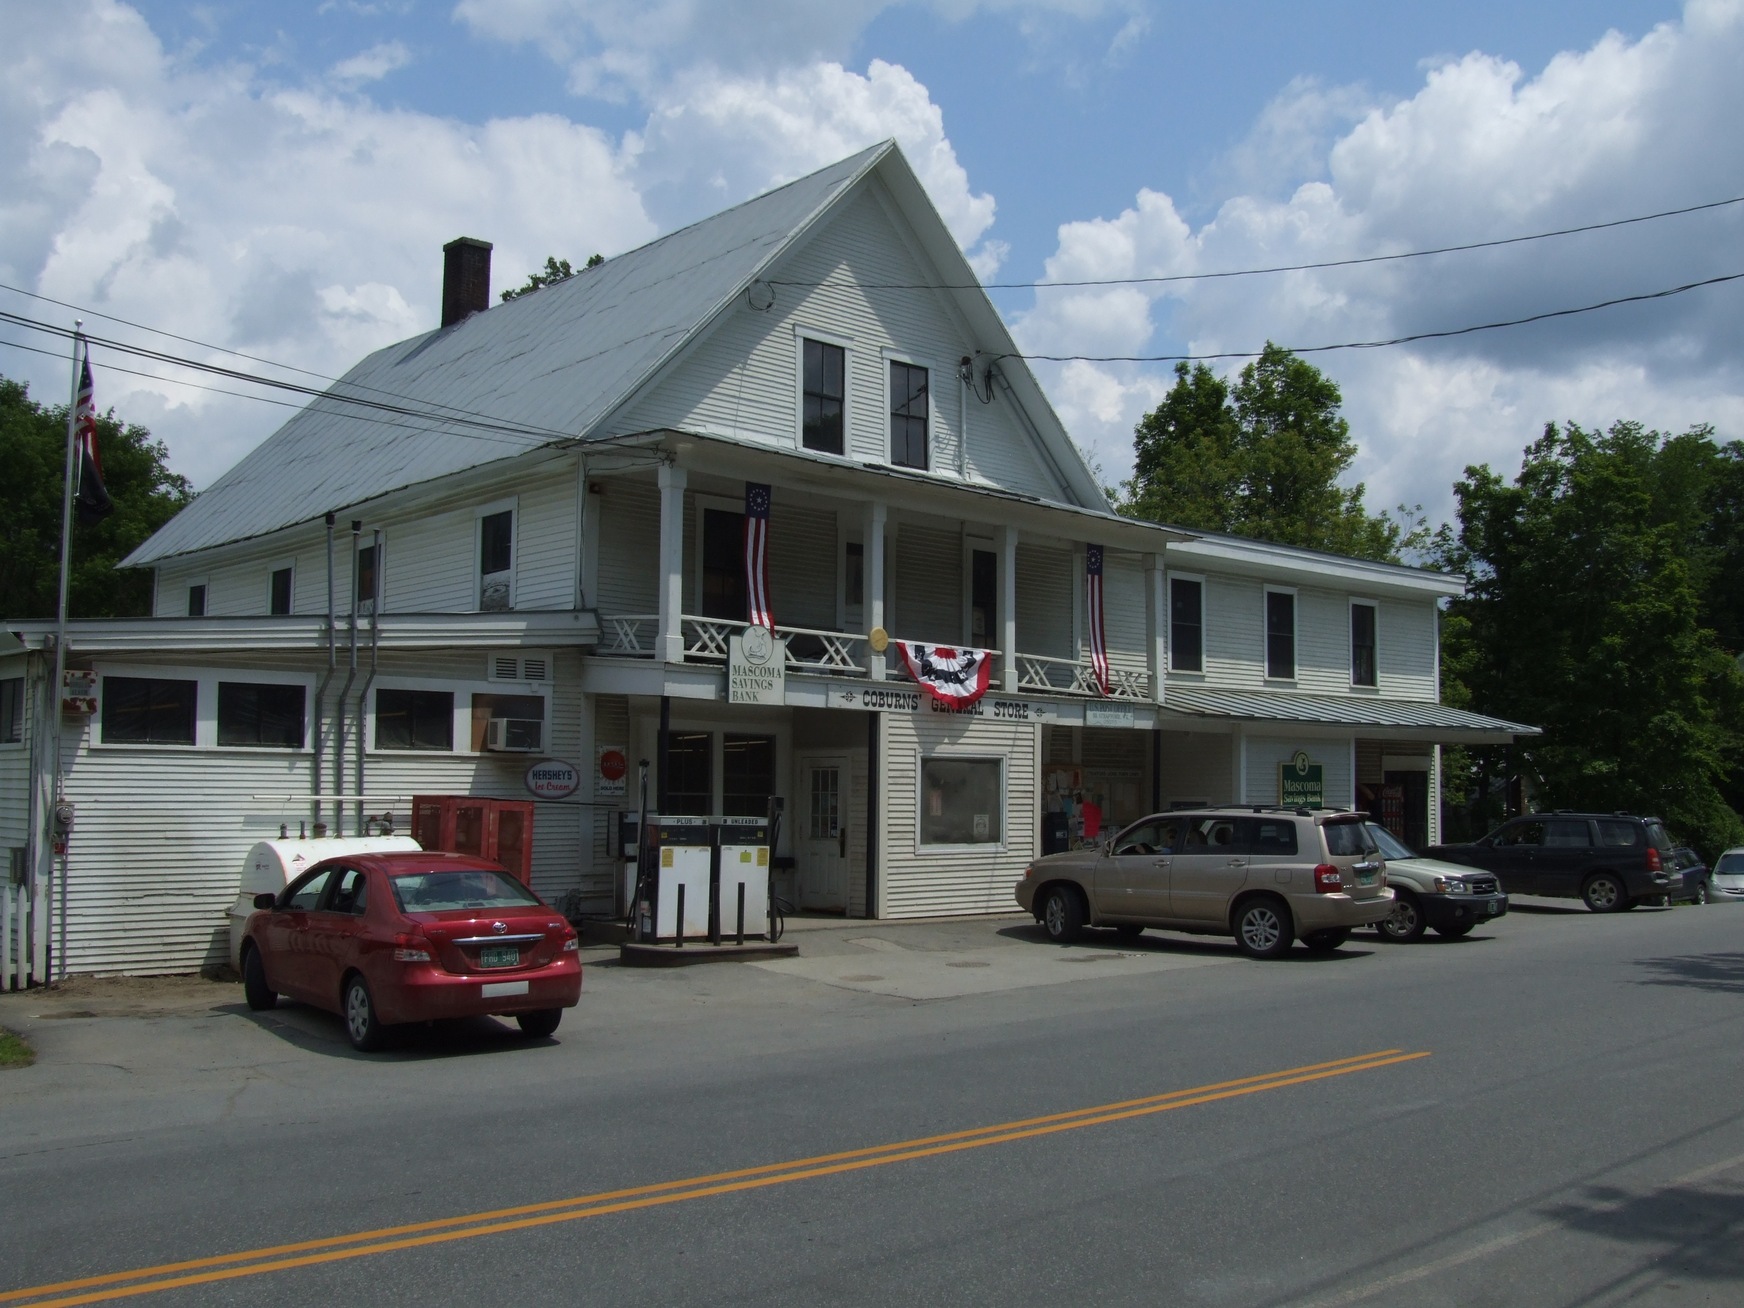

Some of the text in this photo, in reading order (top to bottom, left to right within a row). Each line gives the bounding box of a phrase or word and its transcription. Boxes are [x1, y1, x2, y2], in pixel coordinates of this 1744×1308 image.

[732, 665, 781, 678] MASCOMA
[732, 678, 773, 690] SAVINGS
[732, 691, 759, 702] BANK
[862, 690, 922, 710] COBURNS'
[994, 701, 1029, 719] STORE
[532, 770, 572, 780] HERSHEY'S
[535, 781, 571, 790] Ice Cream
[1283, 779, 1321, 792] Mascoma
[1283, 793, 1321, 805] Savings Bank
